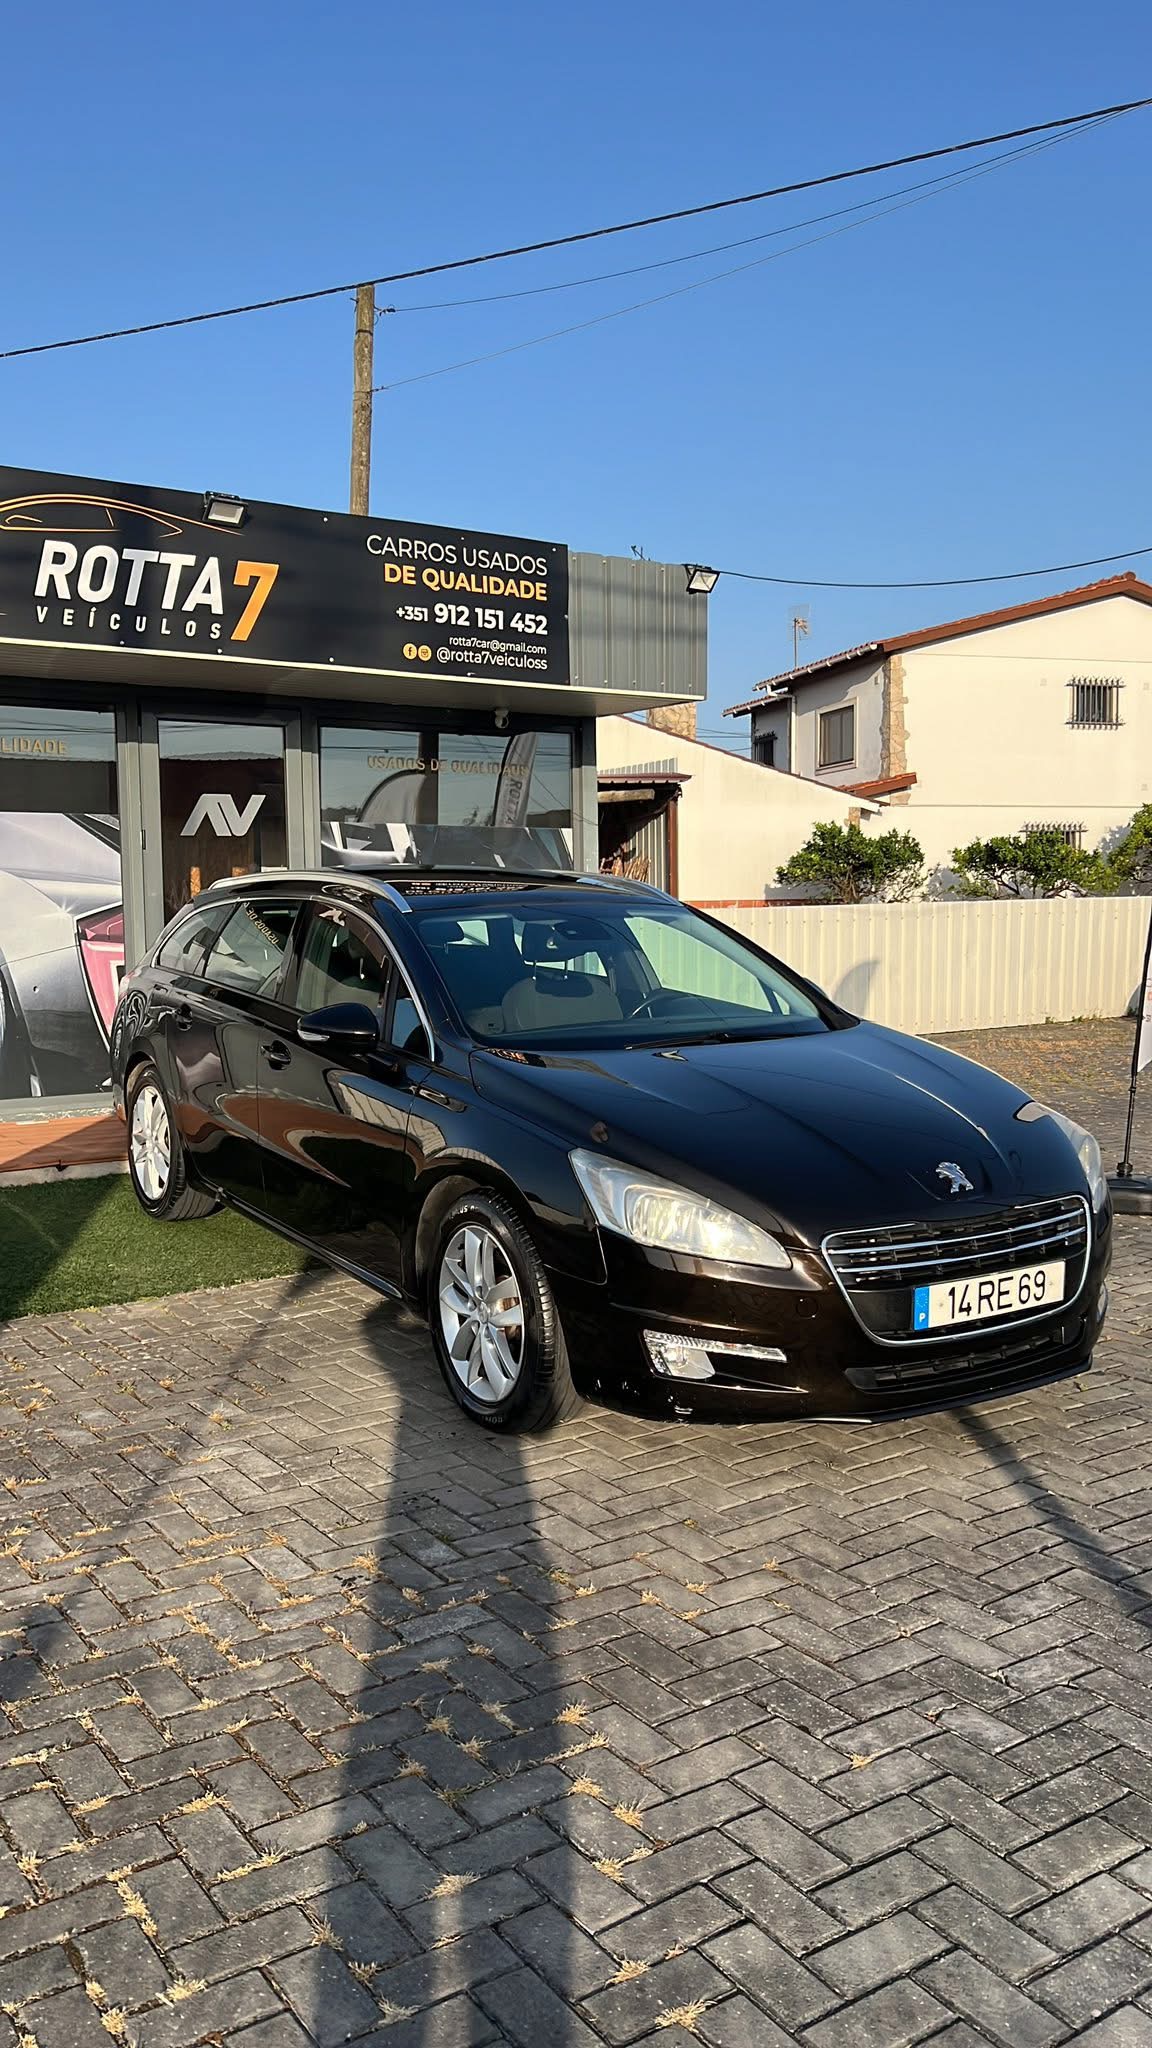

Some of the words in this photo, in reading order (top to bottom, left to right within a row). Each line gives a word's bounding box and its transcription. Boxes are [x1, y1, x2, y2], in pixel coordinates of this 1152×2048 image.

[367, 534, 457, 564] CARROS
[462, 546, 548, 576] USADOS
[384, 562, 416, 585] DE
[422, 567, 548, 601] QUALIDADE
[36, 605, 222, 640] VEÍCULOS
[396, 605, 428, 621] +351
[433, 602, 470, 626] 912
[474, 607, 504, 630] 151
[510, 612, 548, 635] 452
[436, 646, 548, 670] @rotta7veiculoss
[449, 636, 547, 655] rotta7car@gmail.com
[0, 736, 69, 755] LIDADE
